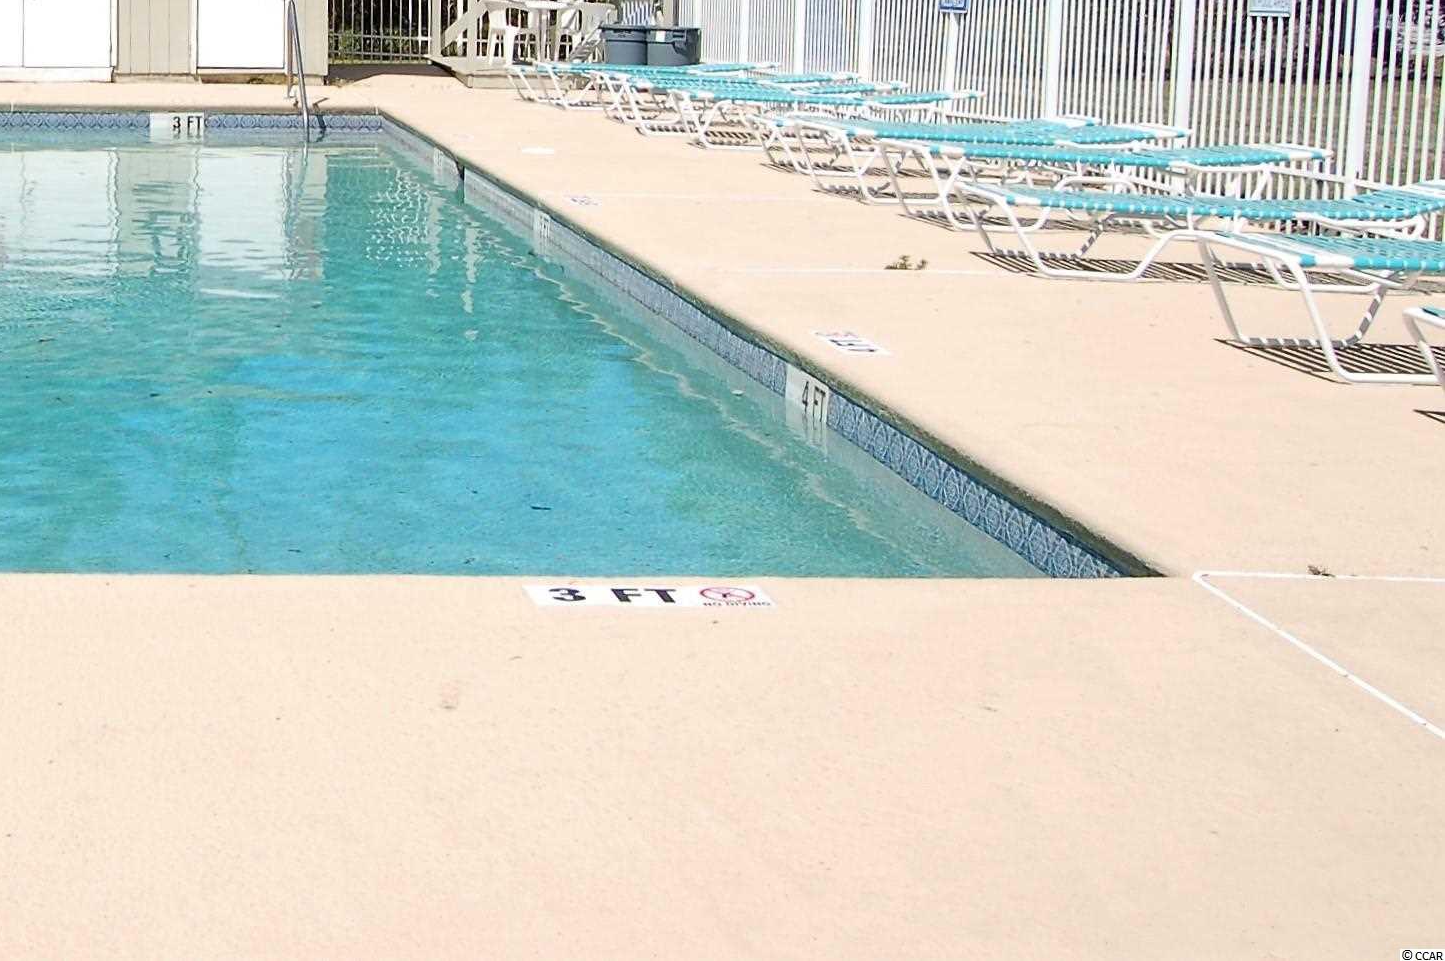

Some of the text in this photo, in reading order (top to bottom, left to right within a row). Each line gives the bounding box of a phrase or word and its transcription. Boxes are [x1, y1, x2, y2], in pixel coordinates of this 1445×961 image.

[172, 115, 202, 129] 3 FT
[802, 381, 826, 423] 4 FT
[548, 588, 677, 603] 3 FT
